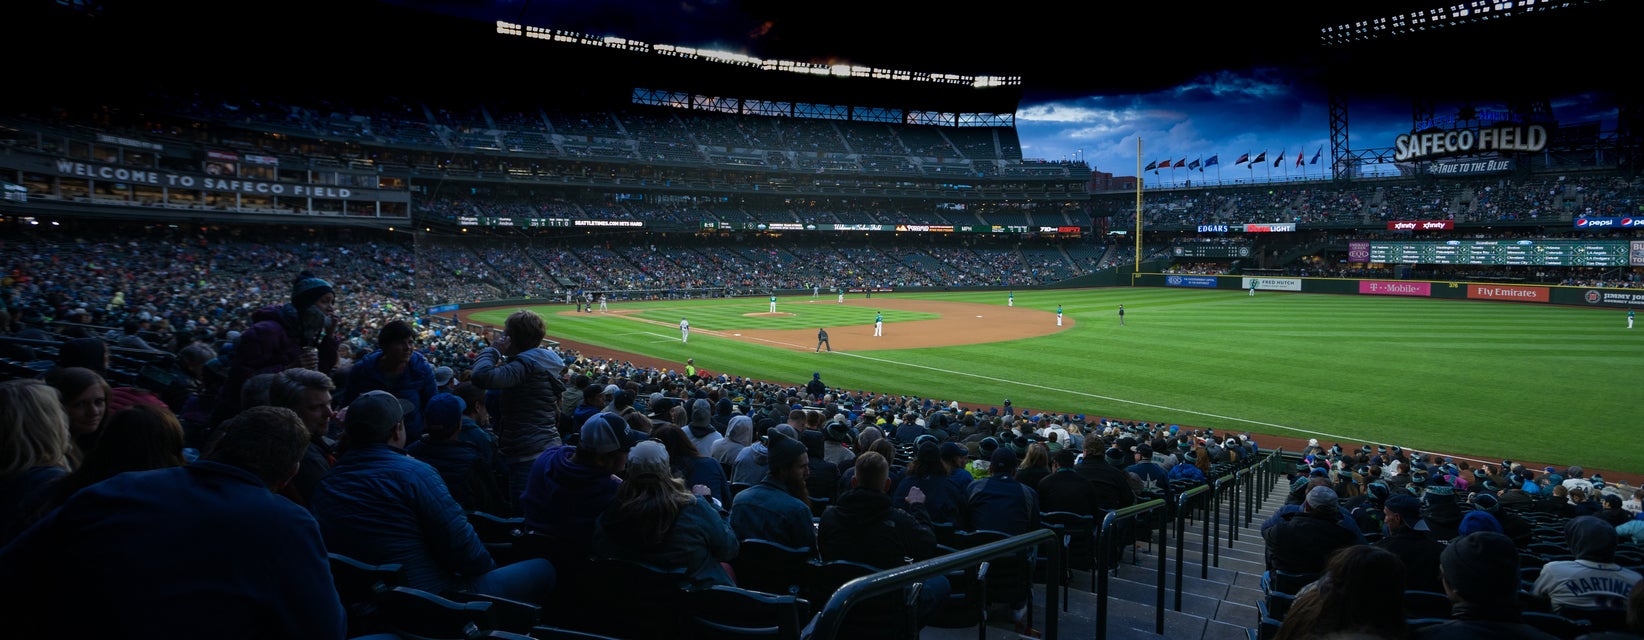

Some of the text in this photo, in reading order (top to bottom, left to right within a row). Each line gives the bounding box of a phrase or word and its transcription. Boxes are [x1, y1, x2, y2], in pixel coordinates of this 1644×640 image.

[1395, 124, 1548, 161] SAFECO FIELD
[1437, 160, 1510, 174] TRUE TO THE BLUE
[56, 159, 351, 198] WELCOME TO SAFECO FIELD
[1198, 225, 1228, 233] EDGARS
[1394, 222, 1417, 230] xfinity
[1588, 219, 1613, 227] pepsi
[1478, 287, 1537, 297] Fly Emirates
[1564, 576, 1633, 597] MARTINE
